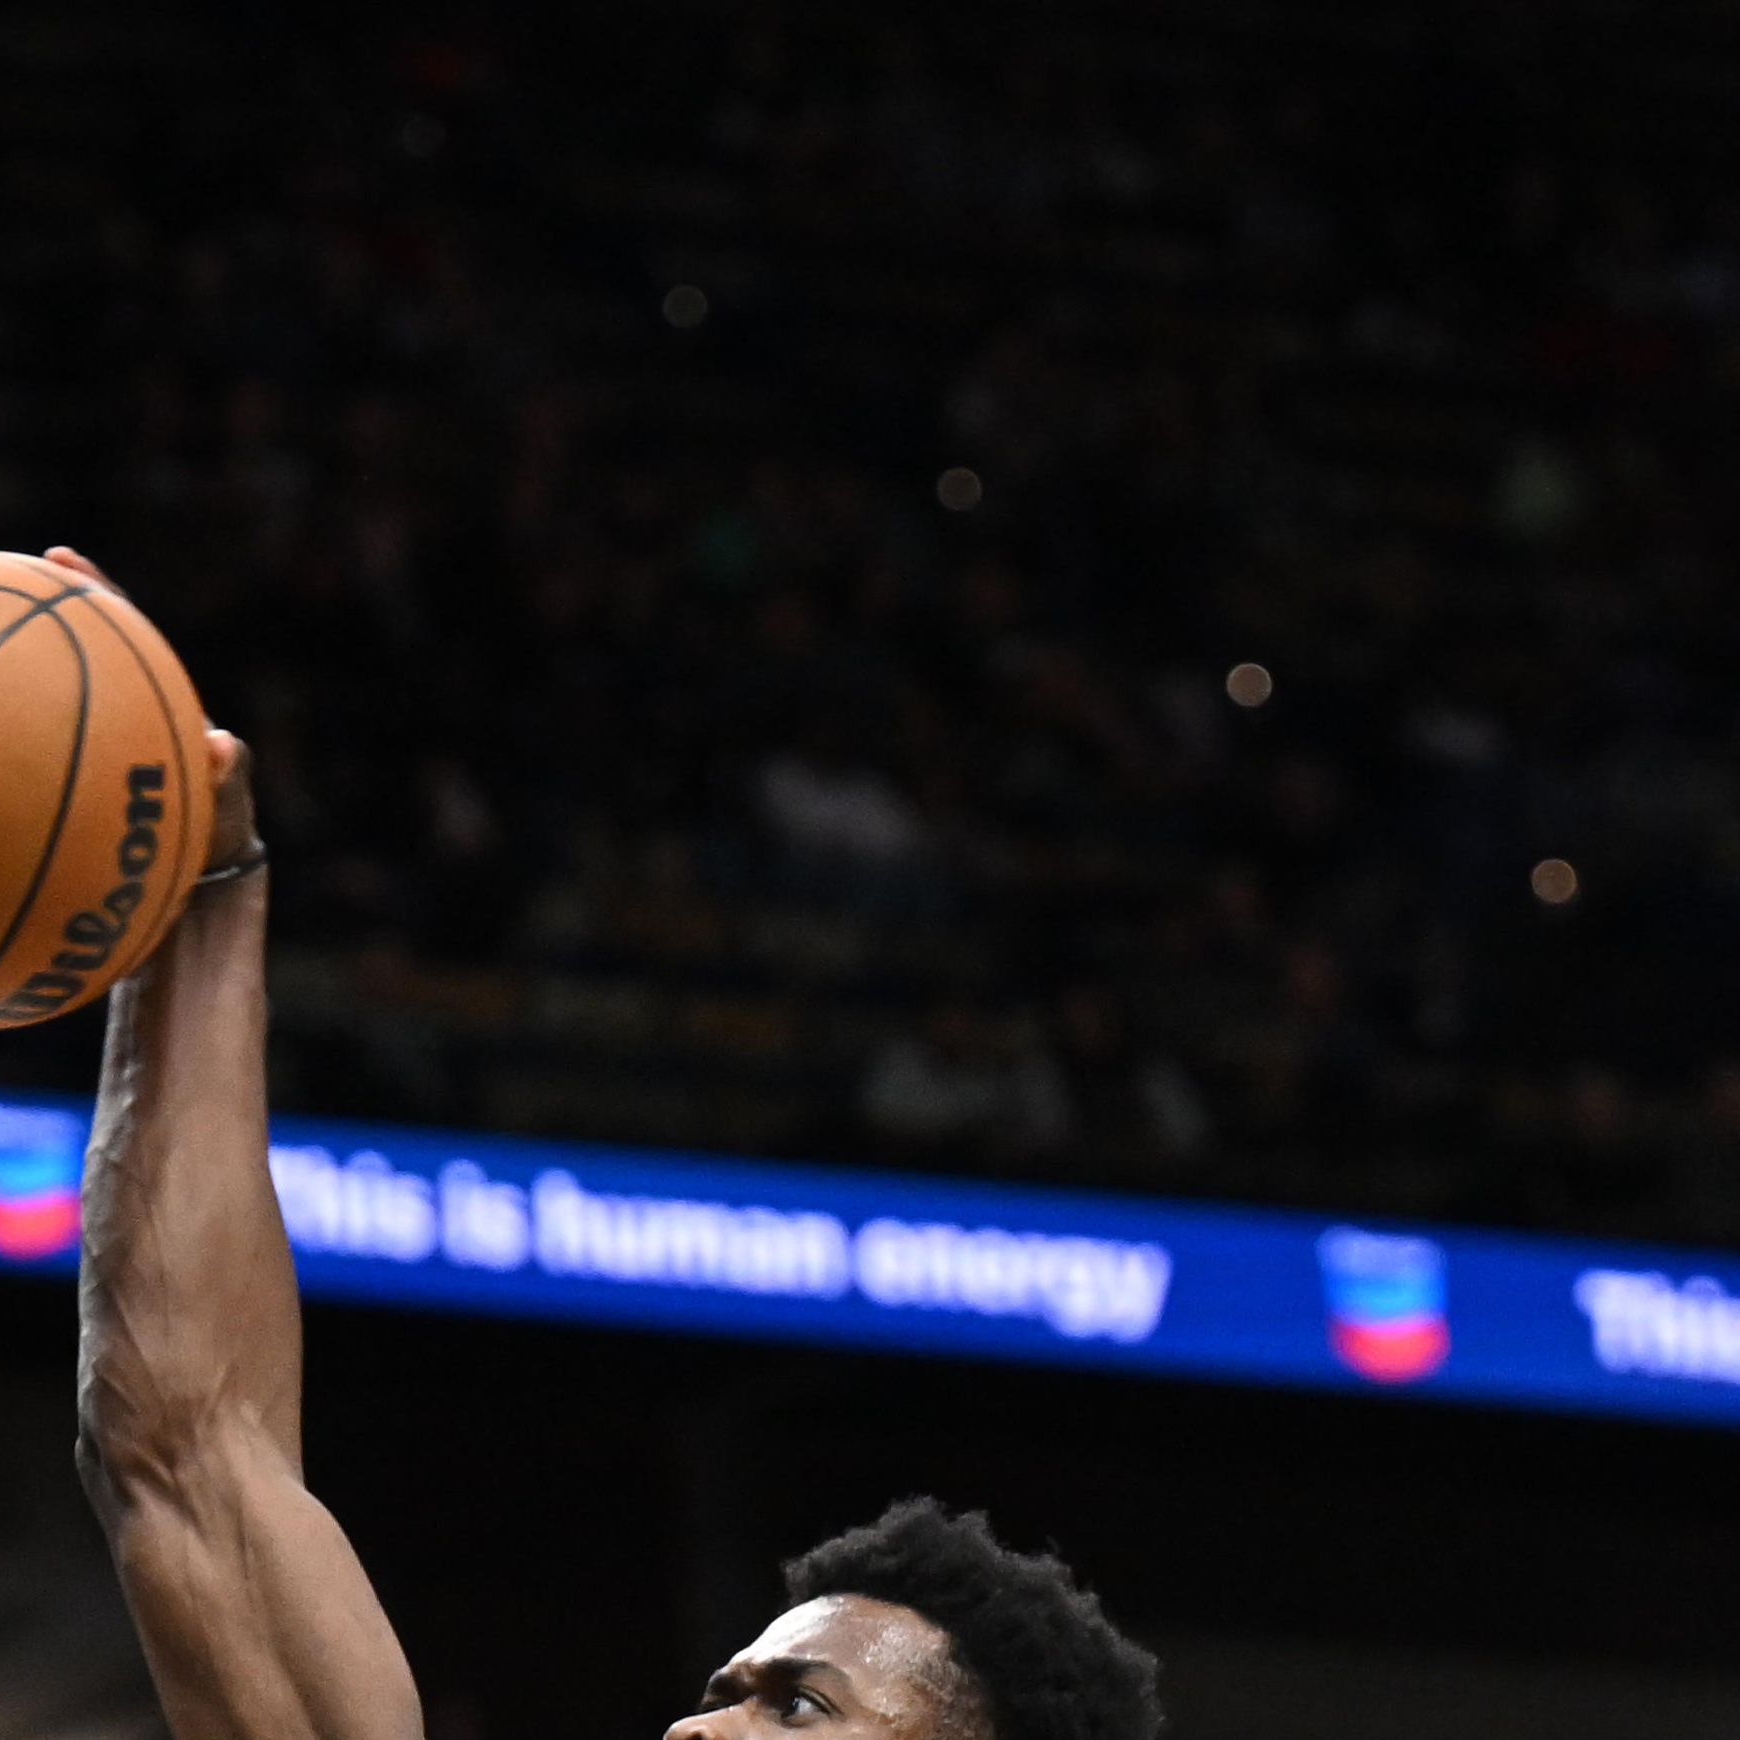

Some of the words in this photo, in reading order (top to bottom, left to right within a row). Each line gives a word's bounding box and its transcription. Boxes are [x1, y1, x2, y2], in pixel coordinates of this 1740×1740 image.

[438, 1159, 532, 1272] is
[531, 1167, 851, 1300] human
[853, 1216, 1172, 1344] energy
